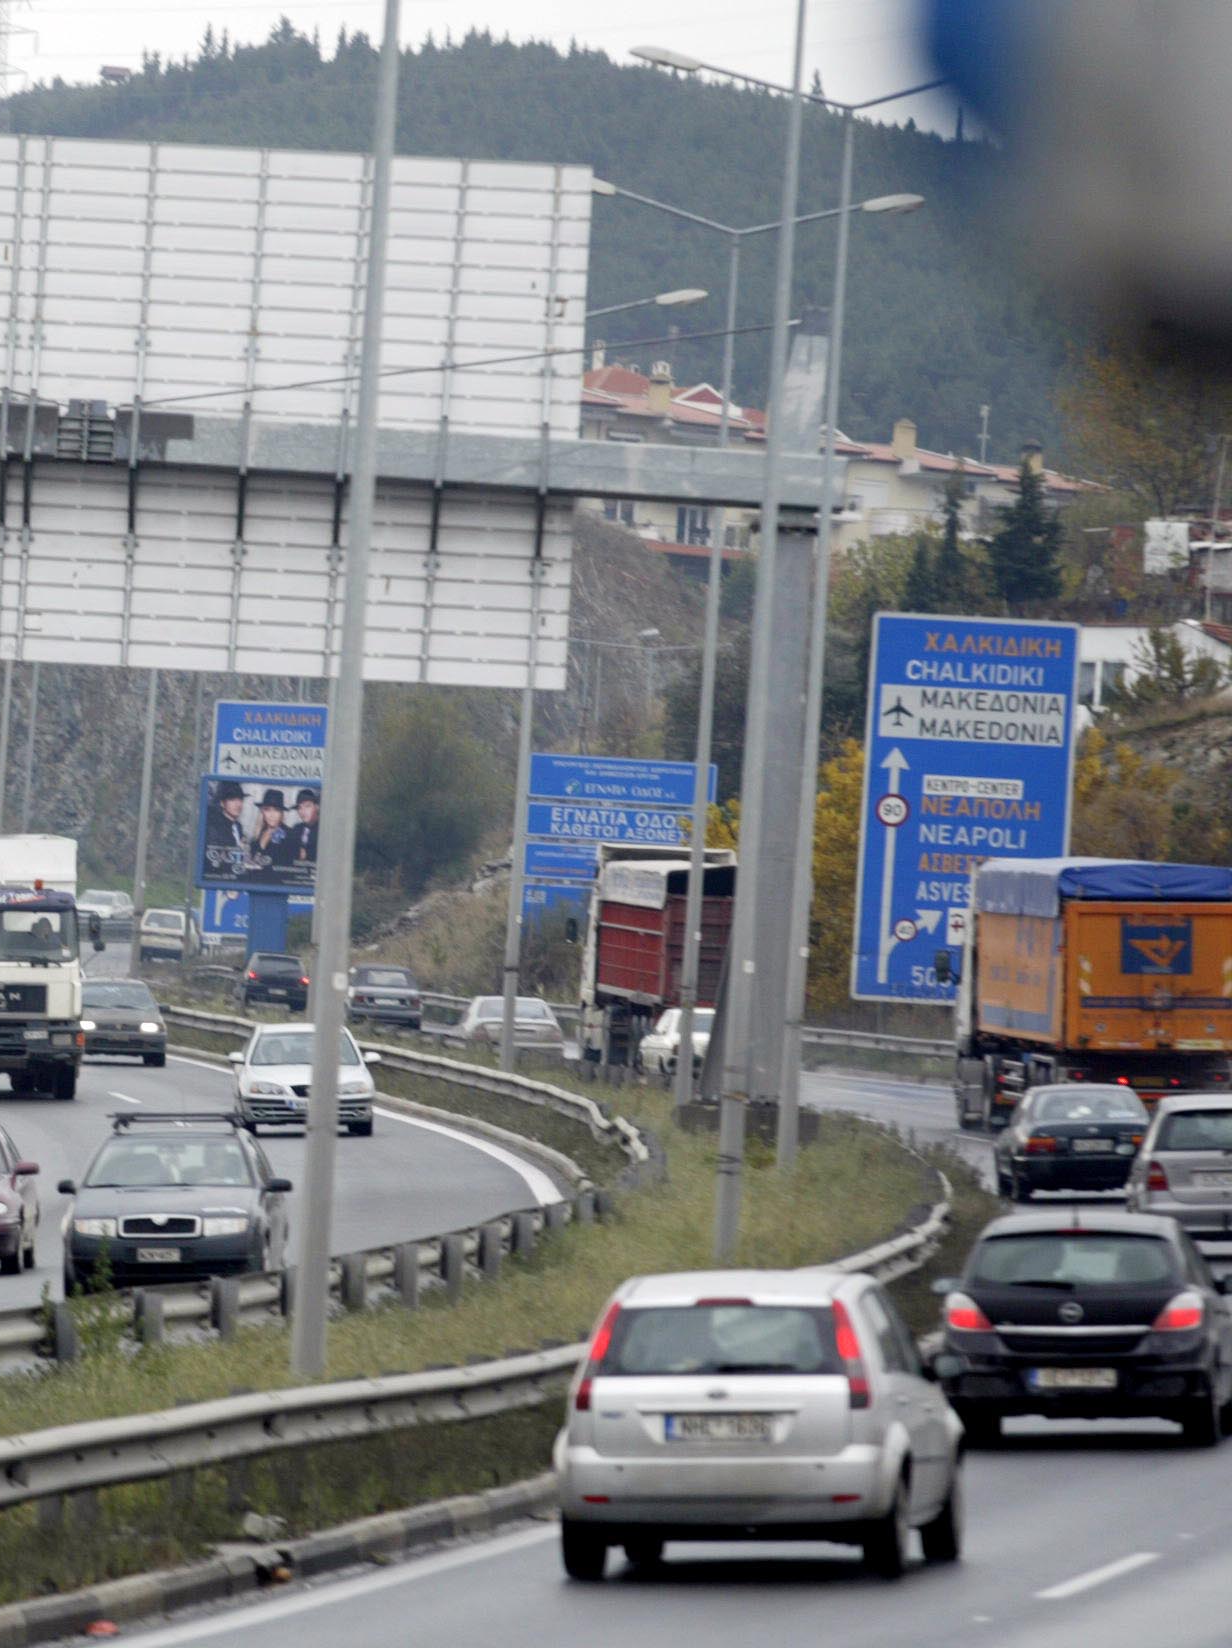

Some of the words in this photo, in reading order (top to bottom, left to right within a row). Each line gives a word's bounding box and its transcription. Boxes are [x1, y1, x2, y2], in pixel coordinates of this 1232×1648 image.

[924, 631, 1063, 658] ΧΑΛΚΙΔΙΚΗ
[905, 659, 1045, 687] CHALKIDIKI
[920, 689, 1063, 716] ΜΑΚΕΔΟΝΙΑ
[244, 710, 322, 727] ΧΑΛΚΙΔΙΚΗ
[232, 727, 312, 744] CHALKIDIKI
[918, 718, 1062, 744] MAKEDONIA
[239, 764, 321, 778] MAKEDONIA
[550, 807, 629, 826] ΕΓΝΑΤΙΑ
[883, 803, 902, 817] 90
[921, 796, 1041, 821] ΝΕΑΠΟΛΗ
[549, 823, 620, 839] ΚΑΘΕΤΟΙ
[918, 824, 1027, 849] NEAPOLI
